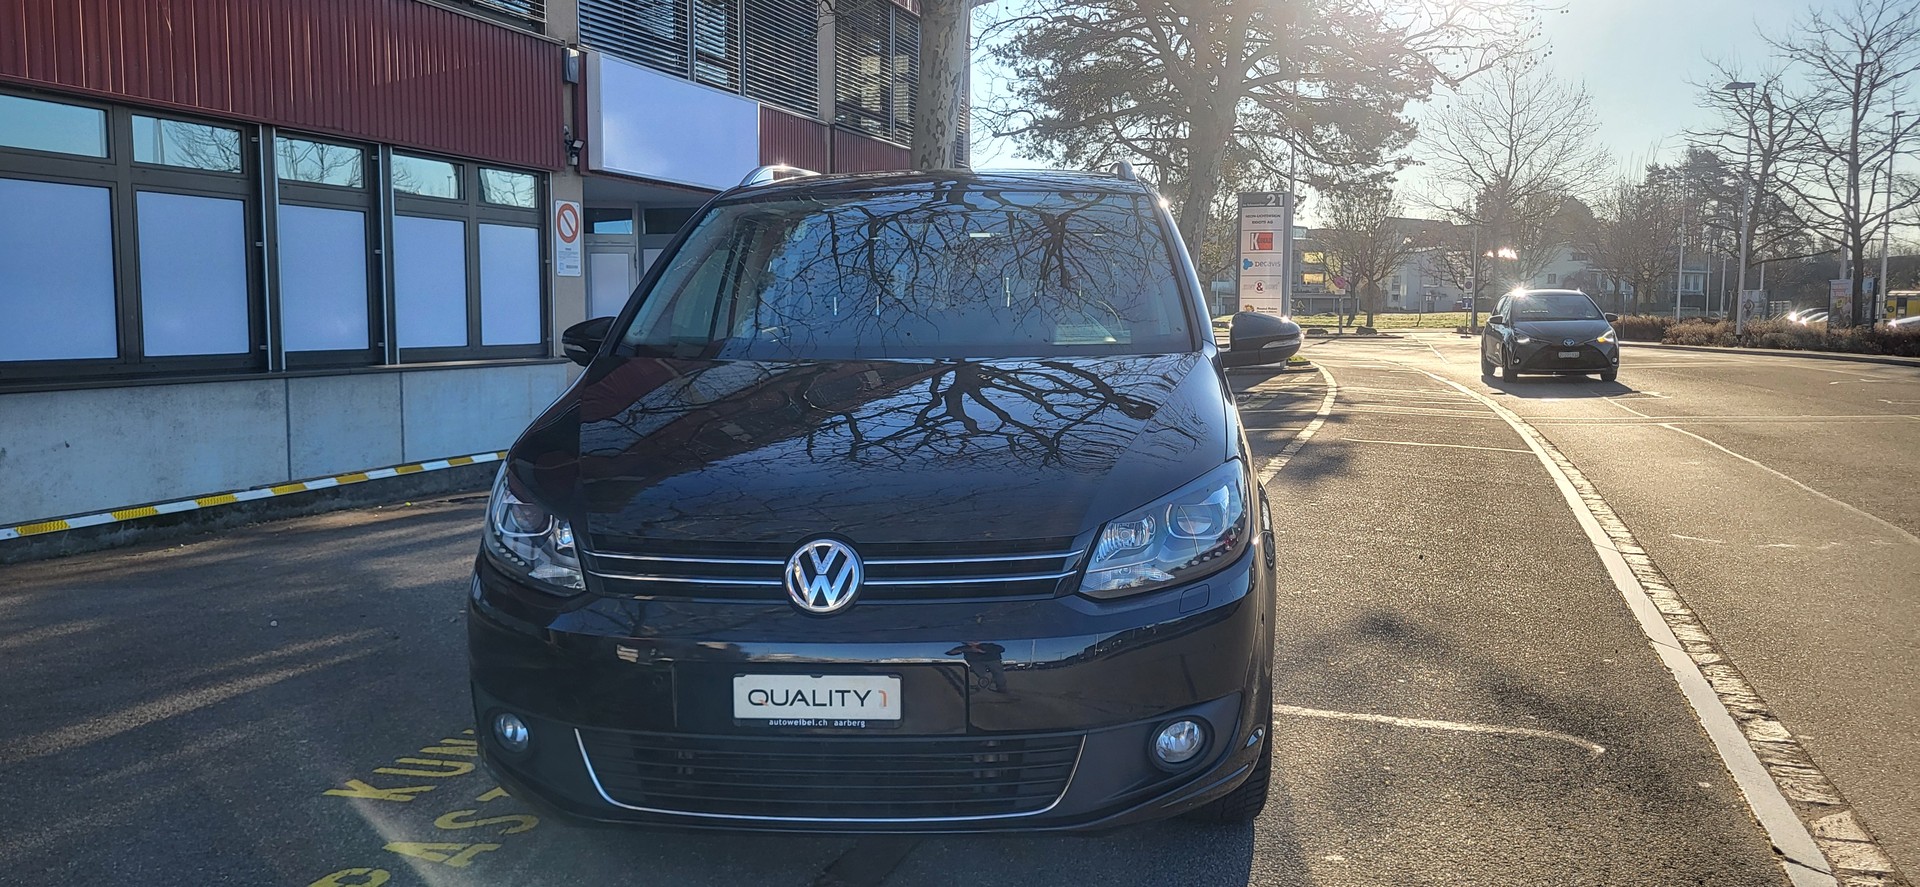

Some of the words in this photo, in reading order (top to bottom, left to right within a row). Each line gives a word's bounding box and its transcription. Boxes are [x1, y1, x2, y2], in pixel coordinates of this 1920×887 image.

[1266, 193, 1284, 206] 21
[748, 689, 872, 707] QUALITY
[878, 689, 889, 708] 1
[768, 718, 828, 727] autoweibel.ch
[833, 719, 866, 728] aarberg
[322, 728, 478, 802] KUN
